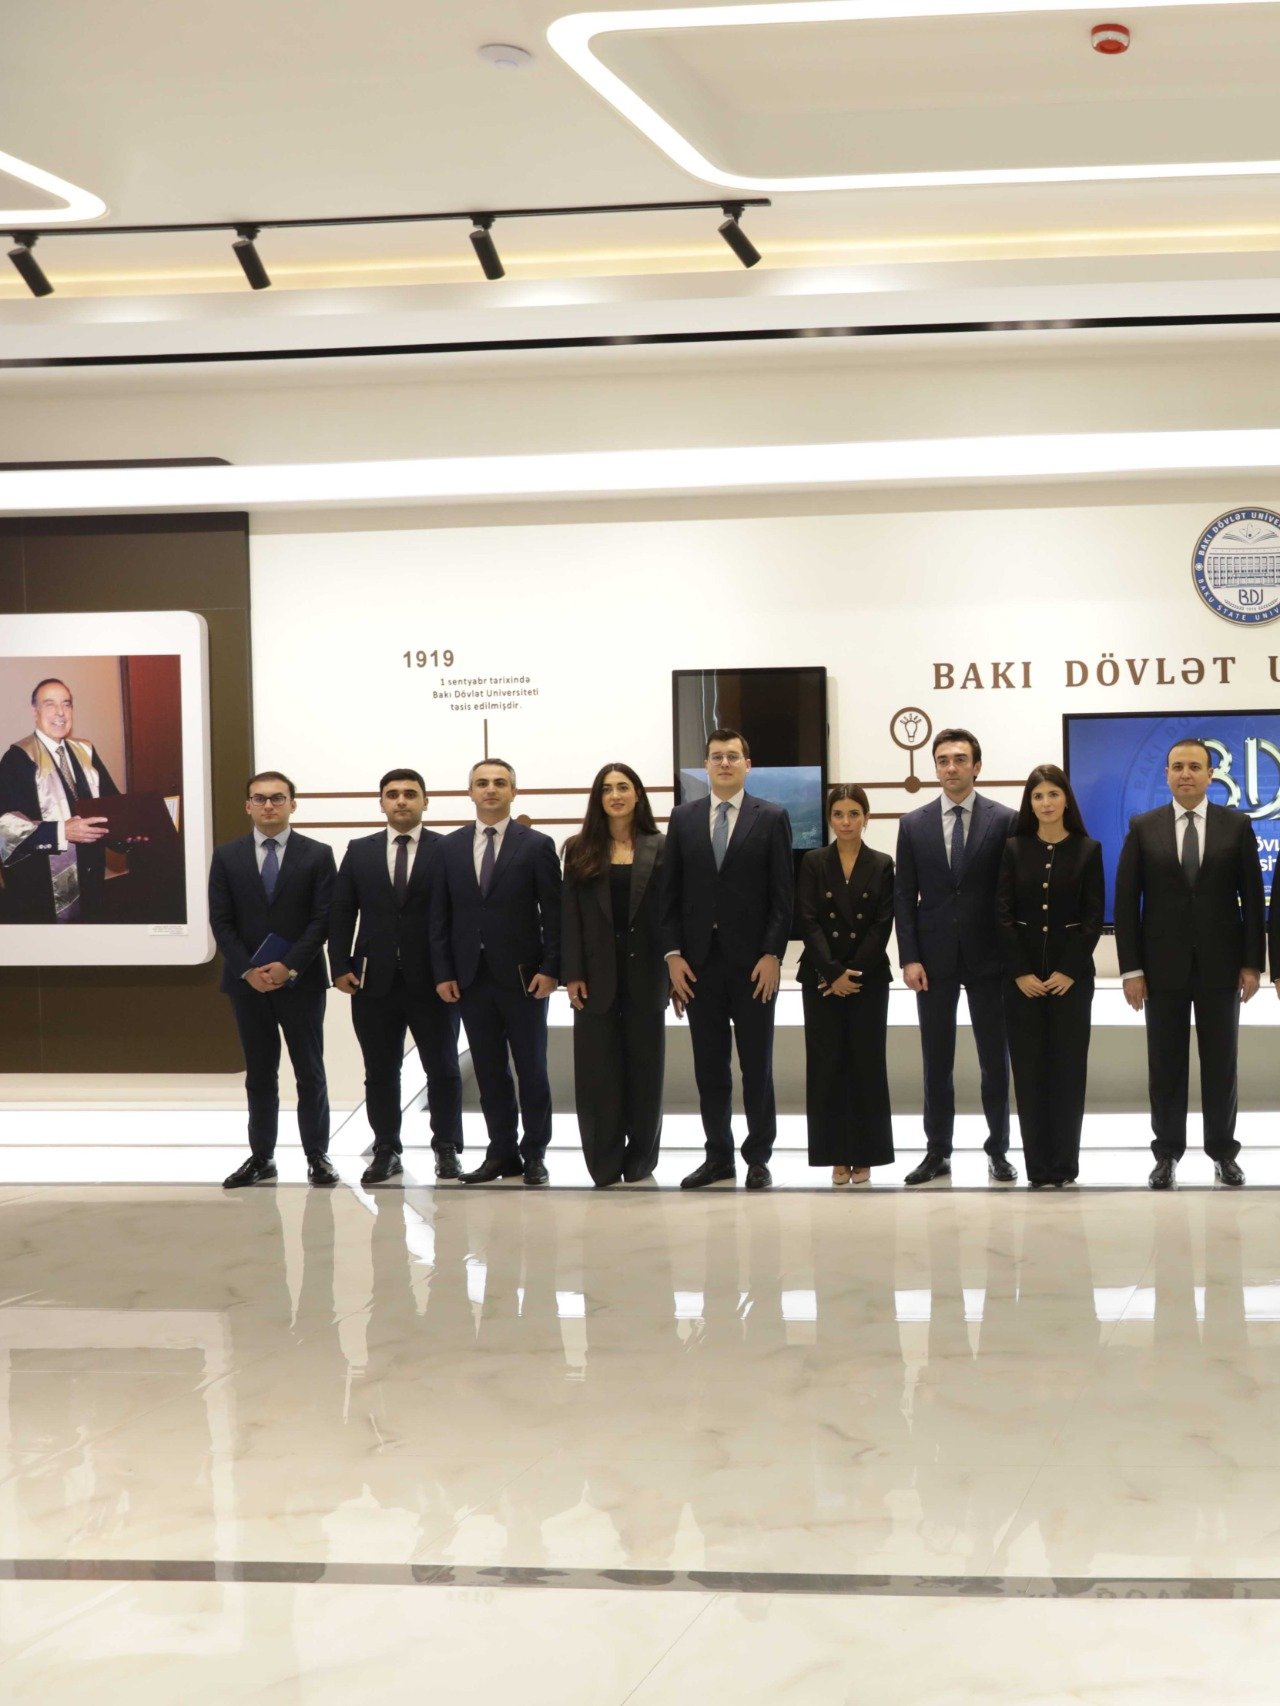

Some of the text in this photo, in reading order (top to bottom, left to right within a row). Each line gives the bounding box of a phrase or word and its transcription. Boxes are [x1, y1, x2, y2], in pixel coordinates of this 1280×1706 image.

[1198, 534, 1213, 556] BAKI
[1212, 512, 1246, 534] DÖVLƏT
[1198, 578, 1215, 603] BAKU
[1216, 604, 1246, 621] STATE
[403, 650, 454, 668] 1919
[932, 661, 1032, 690] BAKI
[1065, 653, 1237, 688] DÖVLƏT
[440, 676, 530, 686] 1 sentyabr tarixində
[433, 688, 538, 699] Bakı Dövlət Universiteti
[450, 703, 471, 711] təsis
